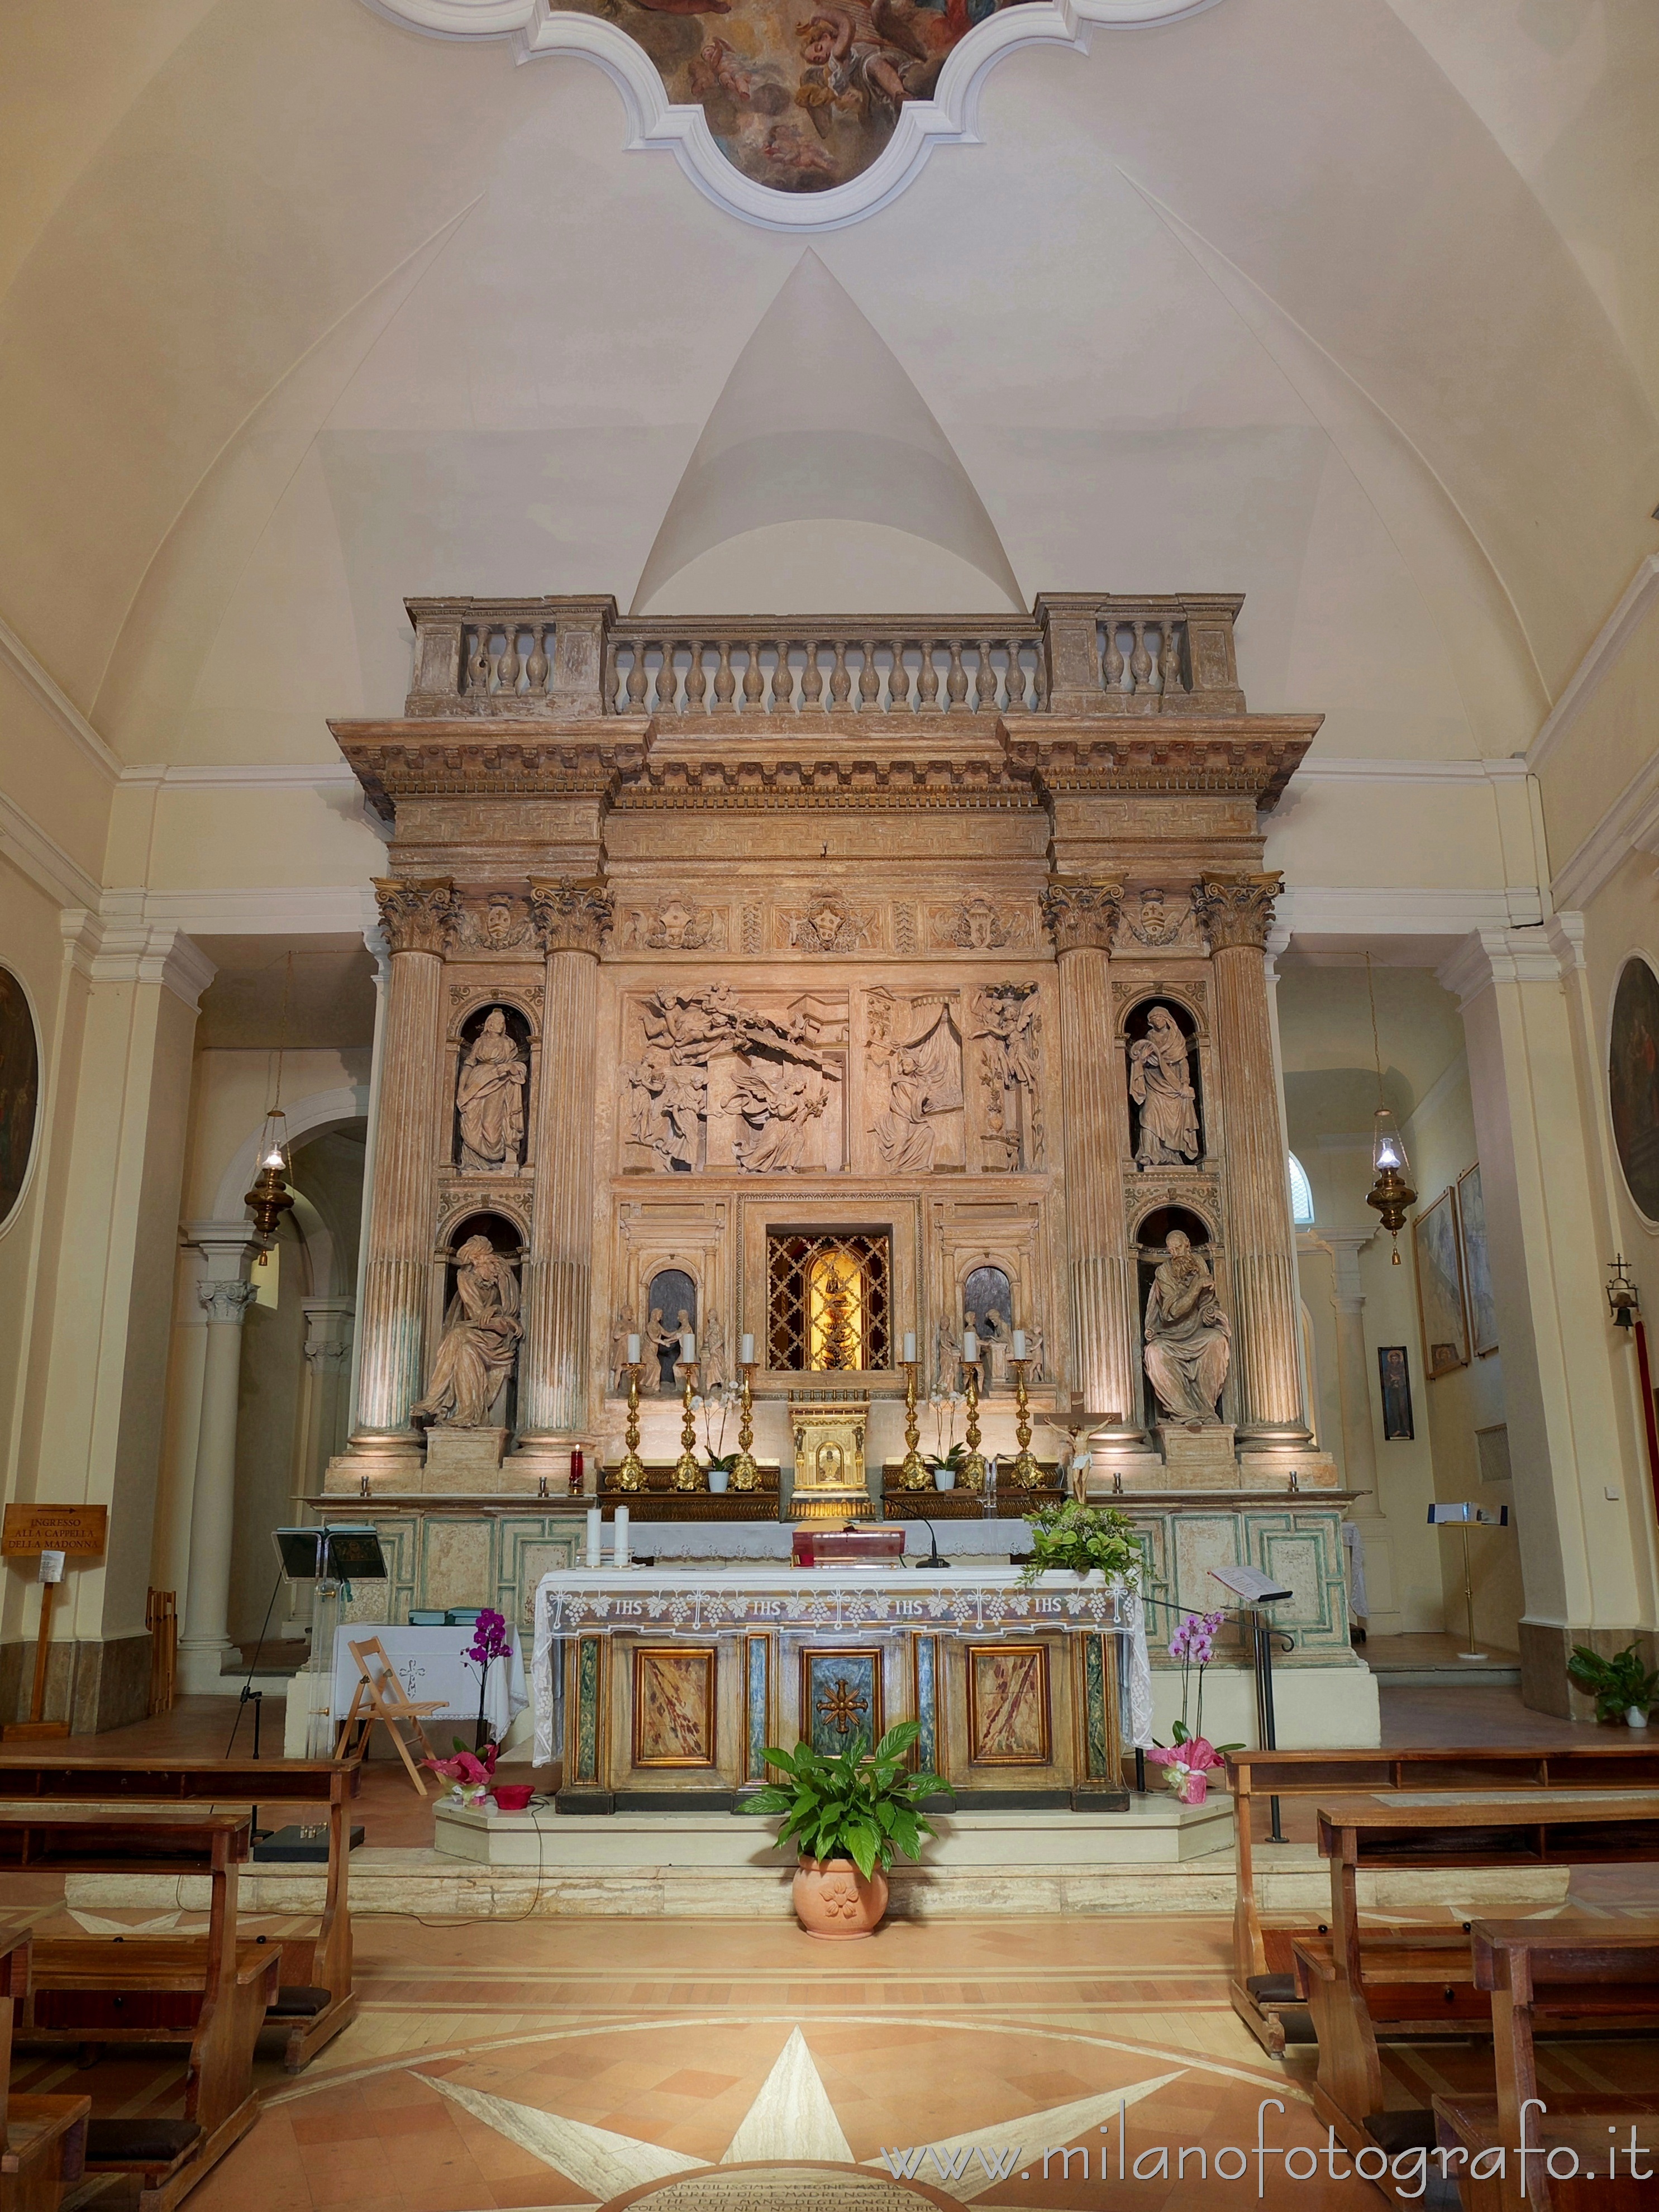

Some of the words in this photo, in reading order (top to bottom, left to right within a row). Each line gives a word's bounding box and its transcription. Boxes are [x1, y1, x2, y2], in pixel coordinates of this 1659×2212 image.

[31, 1519, 81, 1527] INGRESSO
[615, 1600, 642, 1615] IHS
[753, 1601, 781, 1615] IHS
[895, 1600, 922, 1615] IHS
[1035, 1597, 1062, 1613] IHS
